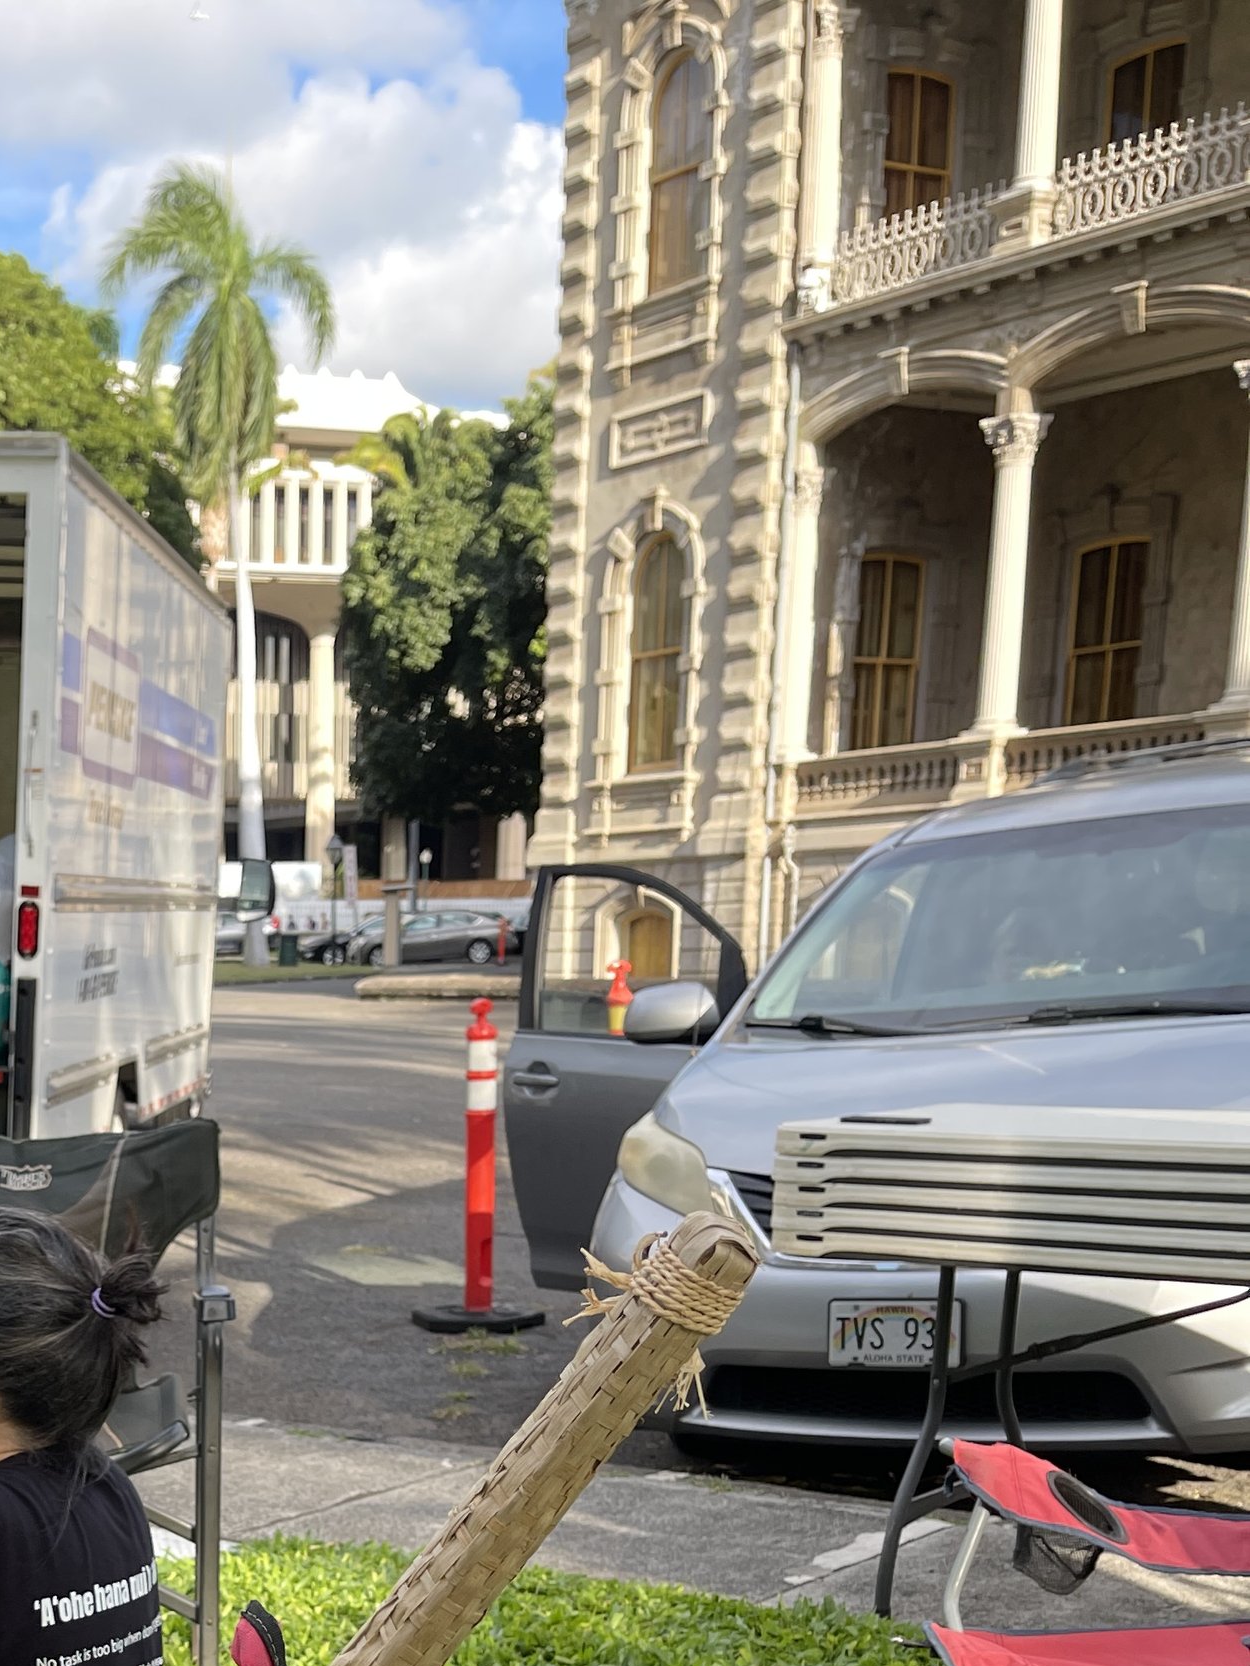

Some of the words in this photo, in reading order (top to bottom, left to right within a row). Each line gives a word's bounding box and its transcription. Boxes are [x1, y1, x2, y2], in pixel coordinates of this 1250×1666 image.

[836, 1317, 885, 1350] TVS
[904, 1317, 937, 1350] 93
[863, 1354, 894, 1363] ALOHA
[896, 1354, 925, 1363] STATE
[93, 1578, 131, 1613] hana
[83, 1648, 92, 1661] is
[92, 1644, 111, 1659] too
[110, 1638, 124, 1654] big
